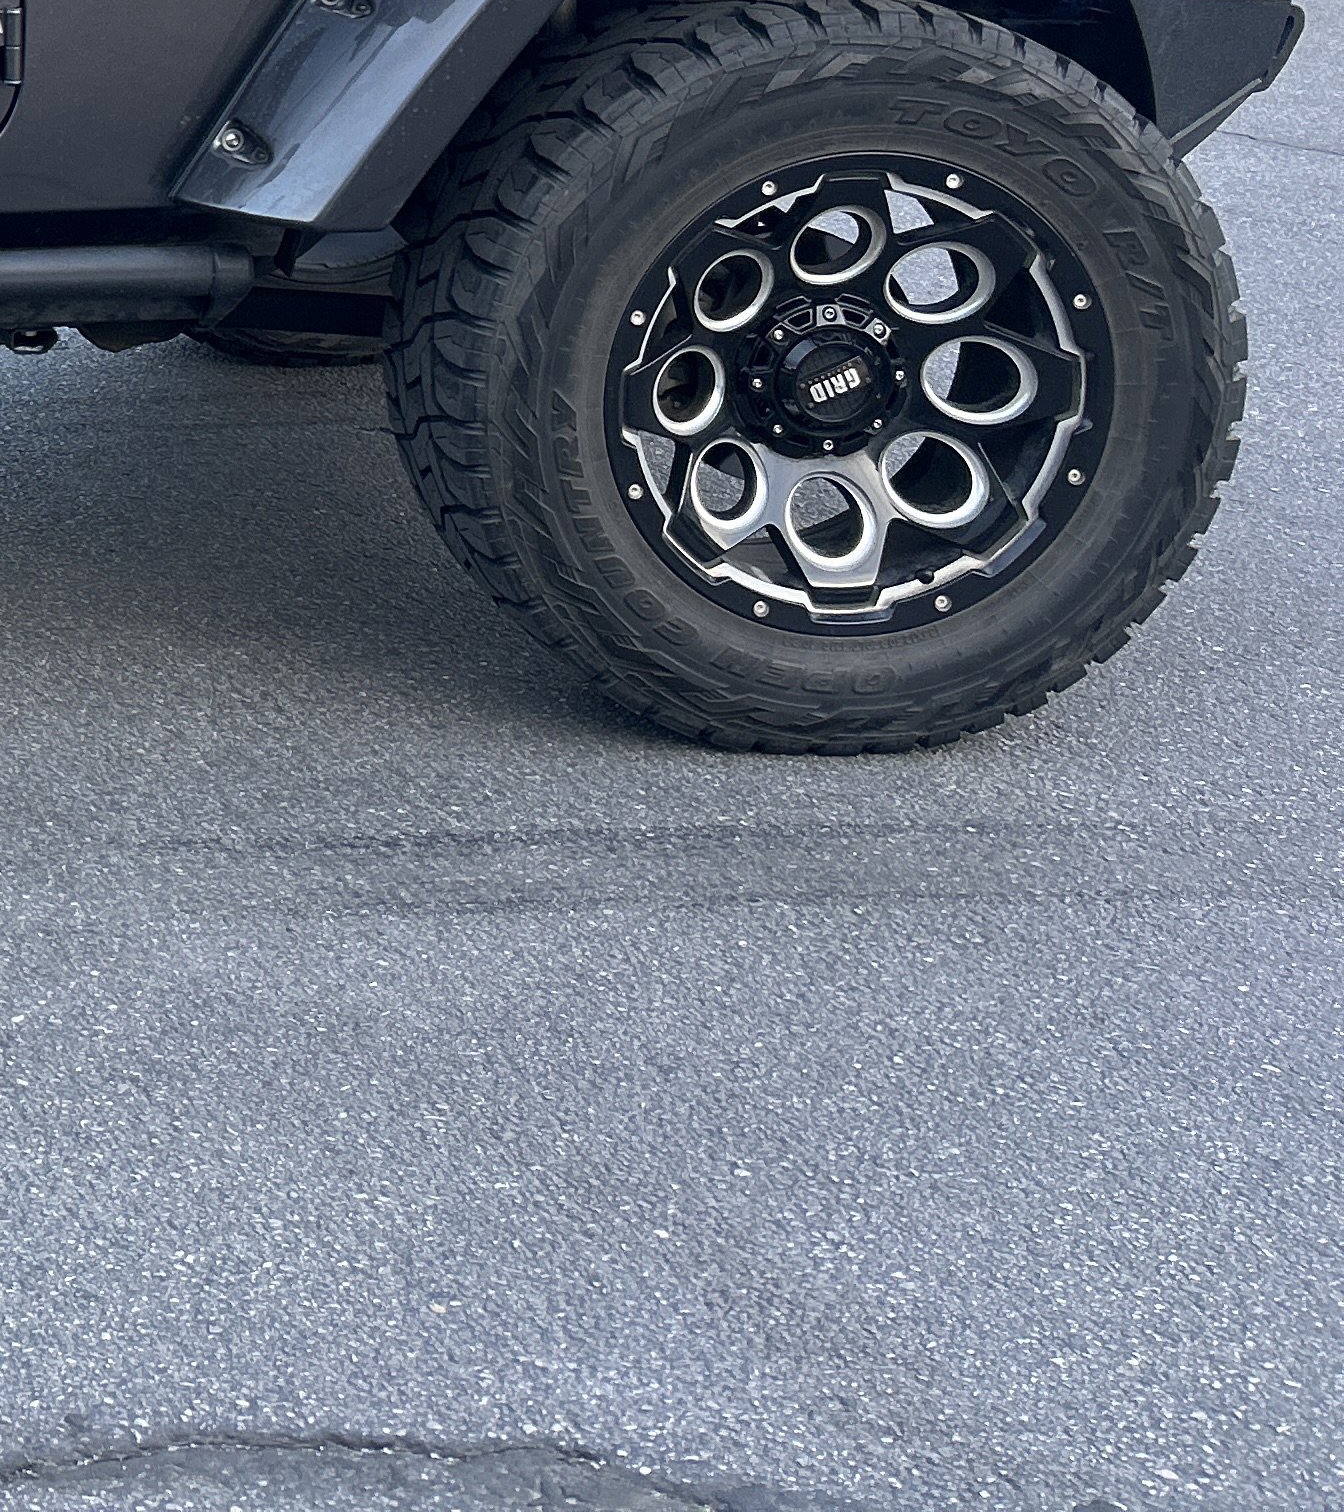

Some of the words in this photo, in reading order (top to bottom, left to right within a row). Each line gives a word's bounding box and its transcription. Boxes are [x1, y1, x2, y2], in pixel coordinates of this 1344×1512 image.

[889, 96, 1097, 196] TOYO
[1103, 227, 1175, 342] R/T
[810, 368, 861, 402] GRID
[552, 390, 701, 645] COUNTRY
